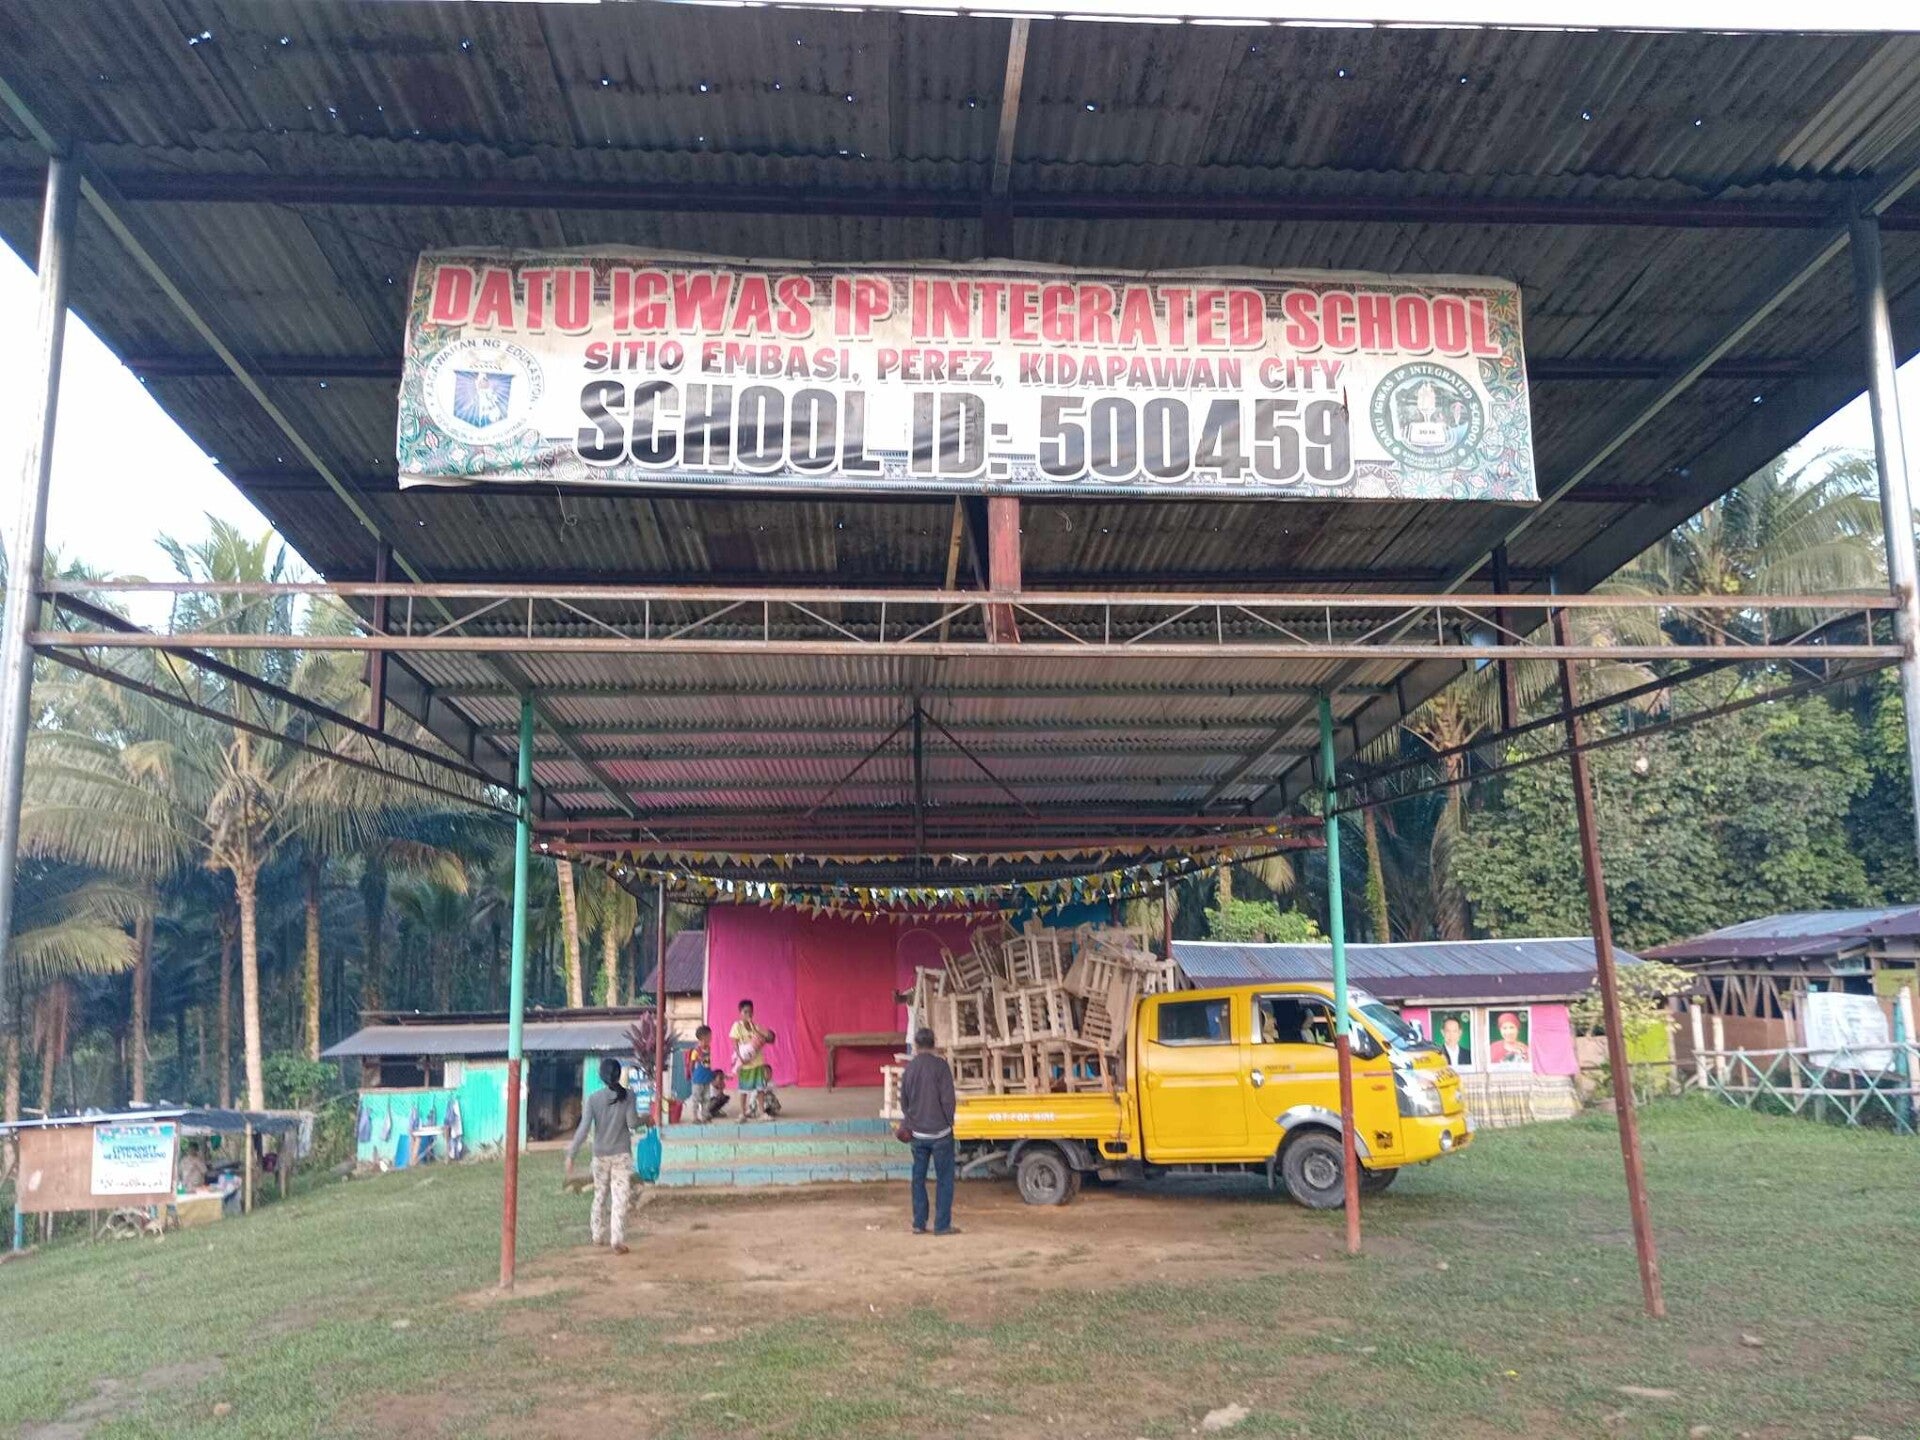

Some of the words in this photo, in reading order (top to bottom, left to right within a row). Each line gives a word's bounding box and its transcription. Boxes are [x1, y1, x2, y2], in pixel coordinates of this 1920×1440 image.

[431, 265, 593, 333] DATU
[612, 268, 813, 338] IGWAS
[834, 277, 892, 338] IP
[910, 278, 1264, 347] INTEGRATED
[1284, 291, 1502, 355] SCHOOL
[482, 338, 501, 349] NG
[583, 341, 685, 372] SITIO
[701, 341, 860, 383] EMBASI,
[876, 348, 1003, 385] PEREZ,
[1019, 352, 1242, 389] KIDAPAWAN
[1258, 357, 1344, 391] CITY
[1394, 369, 1406, 380] IP
[1408, 365, 1473, 399] INTEGRATED
[1373, 379, 1394, 414] IGWAS
[576, 379, 881, 476] SCHOOL
[912, 391, 1009, 476] ID:
[1039, 395, 1350, 481] 500459
[1374, 418, 1394, 447] DATU
[1464, 402, 1481, 447] SCHOOL
